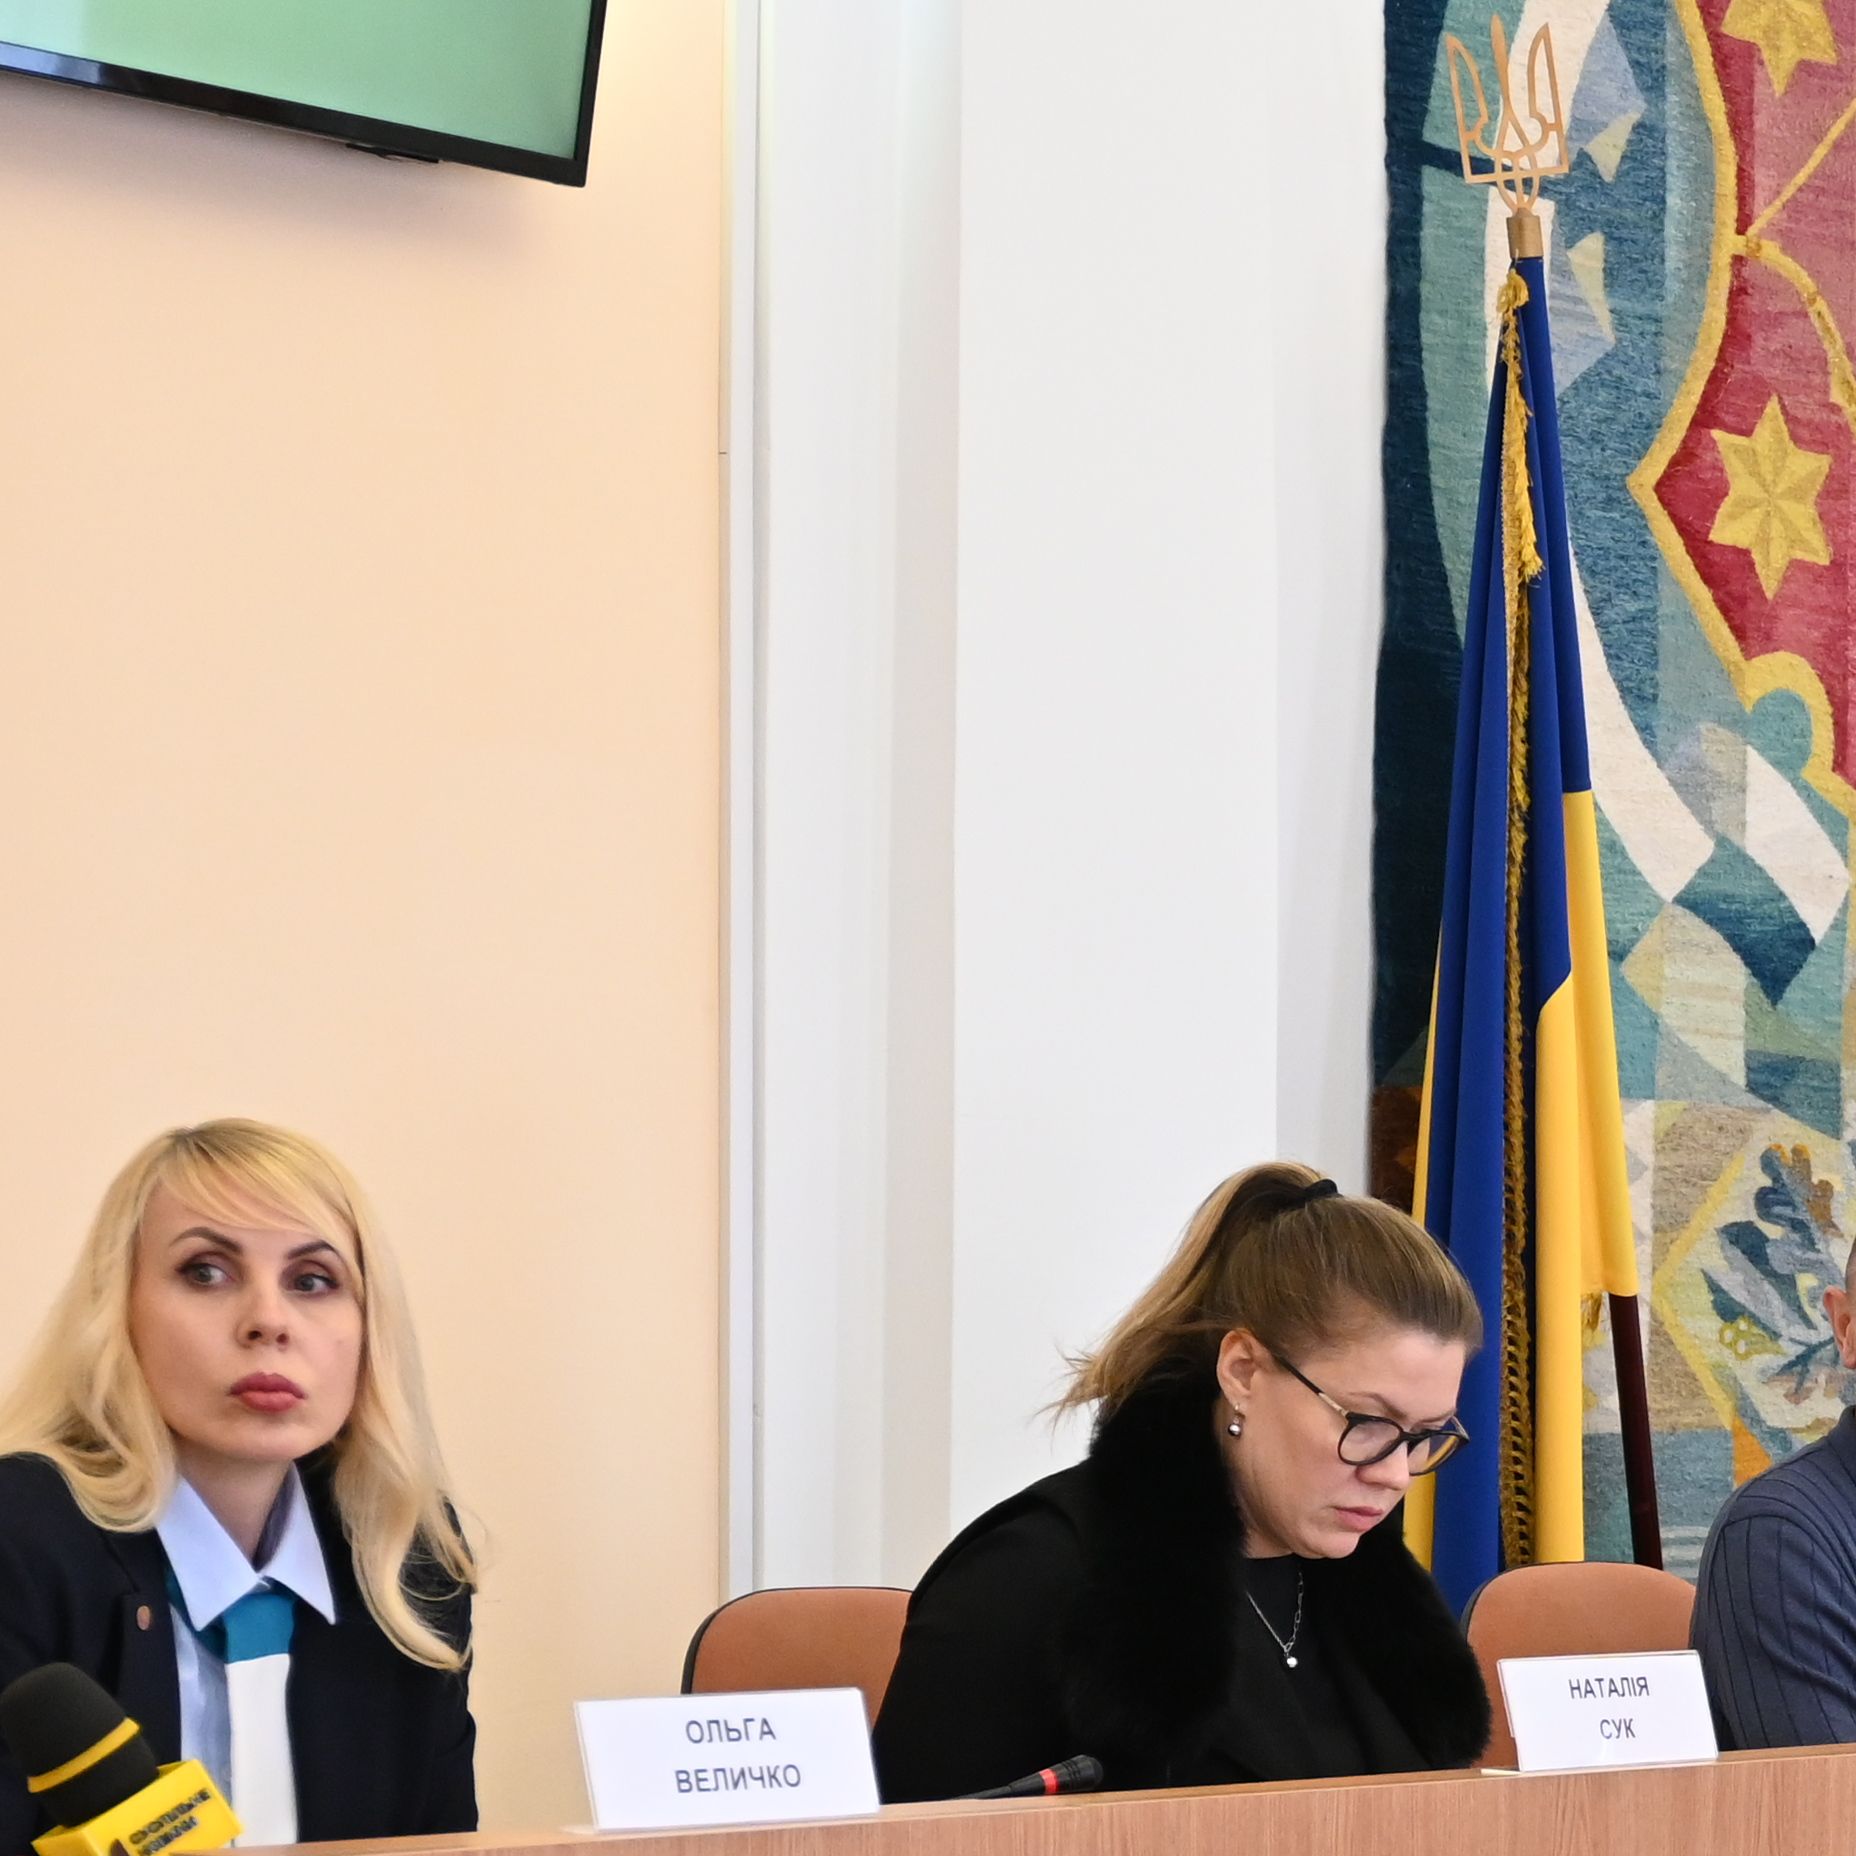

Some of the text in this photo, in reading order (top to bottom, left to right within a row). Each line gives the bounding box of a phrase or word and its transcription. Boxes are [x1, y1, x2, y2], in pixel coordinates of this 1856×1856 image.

[1568, 1676, 1651, 1699] НАТАЛІЯ
[685, 1717, 777, 1744] ОЛЬГА
[1599, 1718, 1637, 1740] СУК
[674, 1763, 802, 1794] ВЕЛИЧКО
